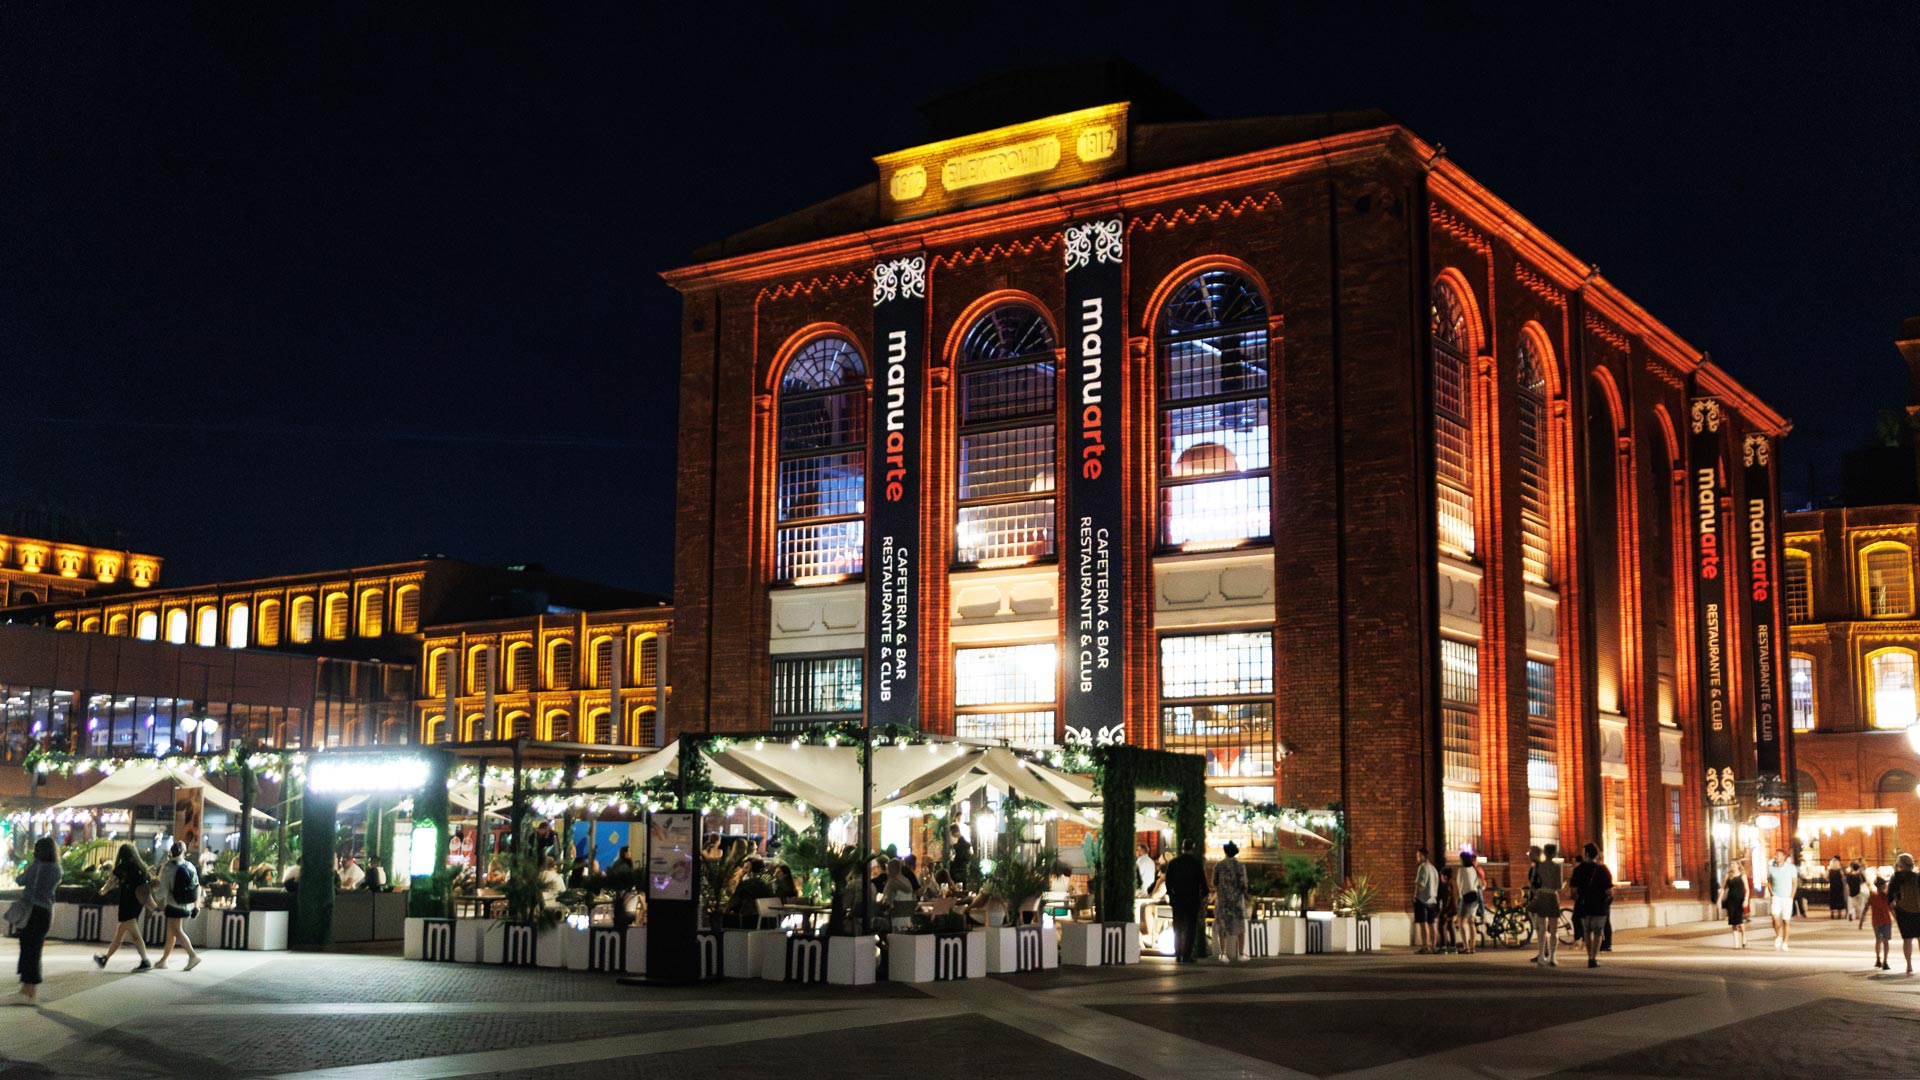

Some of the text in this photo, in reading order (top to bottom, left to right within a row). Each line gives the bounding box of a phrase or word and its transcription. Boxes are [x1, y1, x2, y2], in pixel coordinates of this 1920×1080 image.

[1082, 129, 1115, 155] 1912
[1082, 298, 1105, 480] manuarte
[886, 330, 907, 502] manuarte
[1698, 467, 1720, 580] manuarte
[1749, 499, 1769, 602] manuarte
[880, 536, 893, 702] RESTAURANTE & CLUB
[895, 547, 908, 680] CAFETERIA & BAR
[1080, 516, 1092, 693] RESTAURANTE & CLUB
[1097, 528, 1109, 669] CAFETERIA & BAR
[1706, 603, 1723, 732] RESTAURANTE & CLUB
[1757, 624, 1771, 701] RESTAURANTE
[79, 906, 99, 941] m
[225, 913, 246, 948] m
[426, 922, 451, 962] m
[509, 925, 532, 964] m
[1105, 926, 1123, 965] m
[1250, 923, 1269, 957] m
[1307, 922, 1322, 954] m
[1357, 920, 1371, 951] m
[595, 930, 621, 971] m
[792, 939, 822, 983] m
[940, 936, 962, 980] m
[1020, 927, 1039, 970] m
